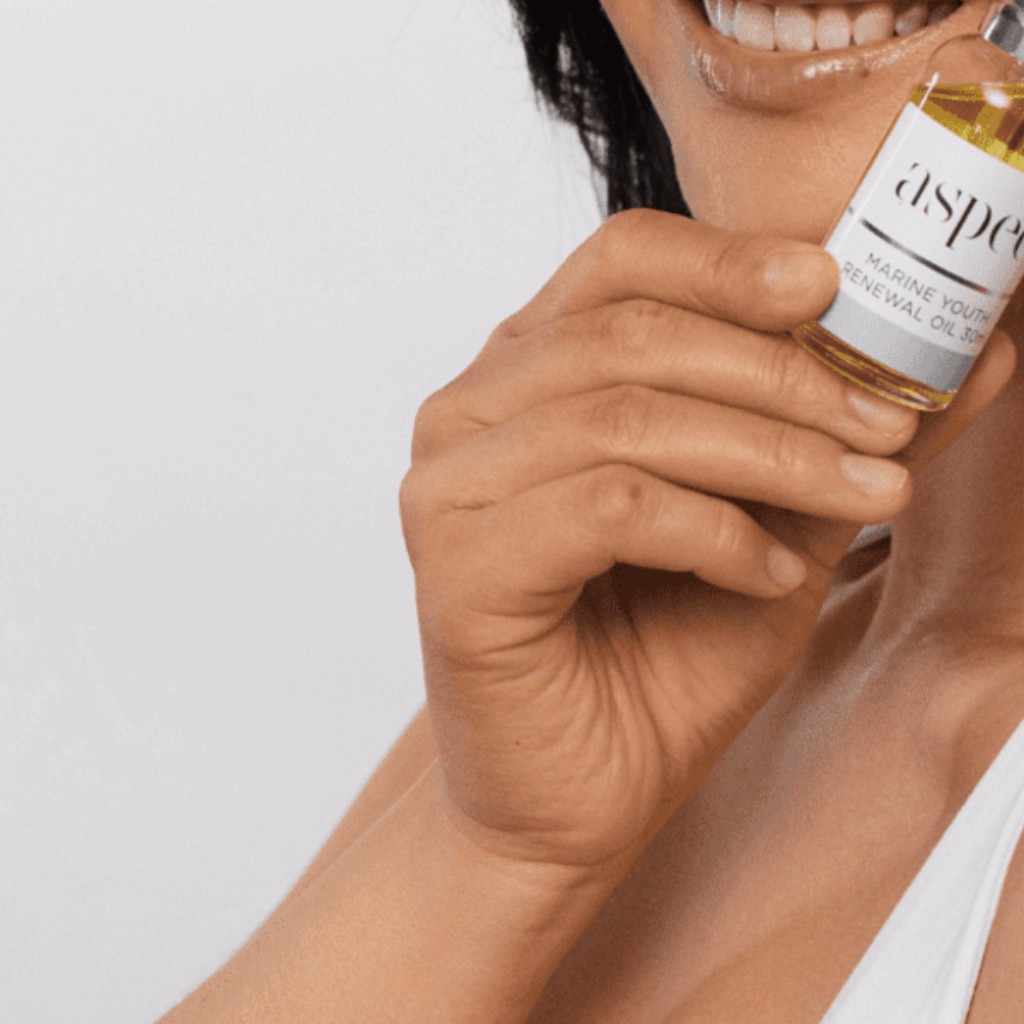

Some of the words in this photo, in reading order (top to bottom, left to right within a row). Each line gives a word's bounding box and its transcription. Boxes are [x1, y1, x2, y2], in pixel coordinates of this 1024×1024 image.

[841, 261, 922, 322] RENEWAL
[930, 315, 957, 337] OIL
[865, 252, 937, 302] MARINE
